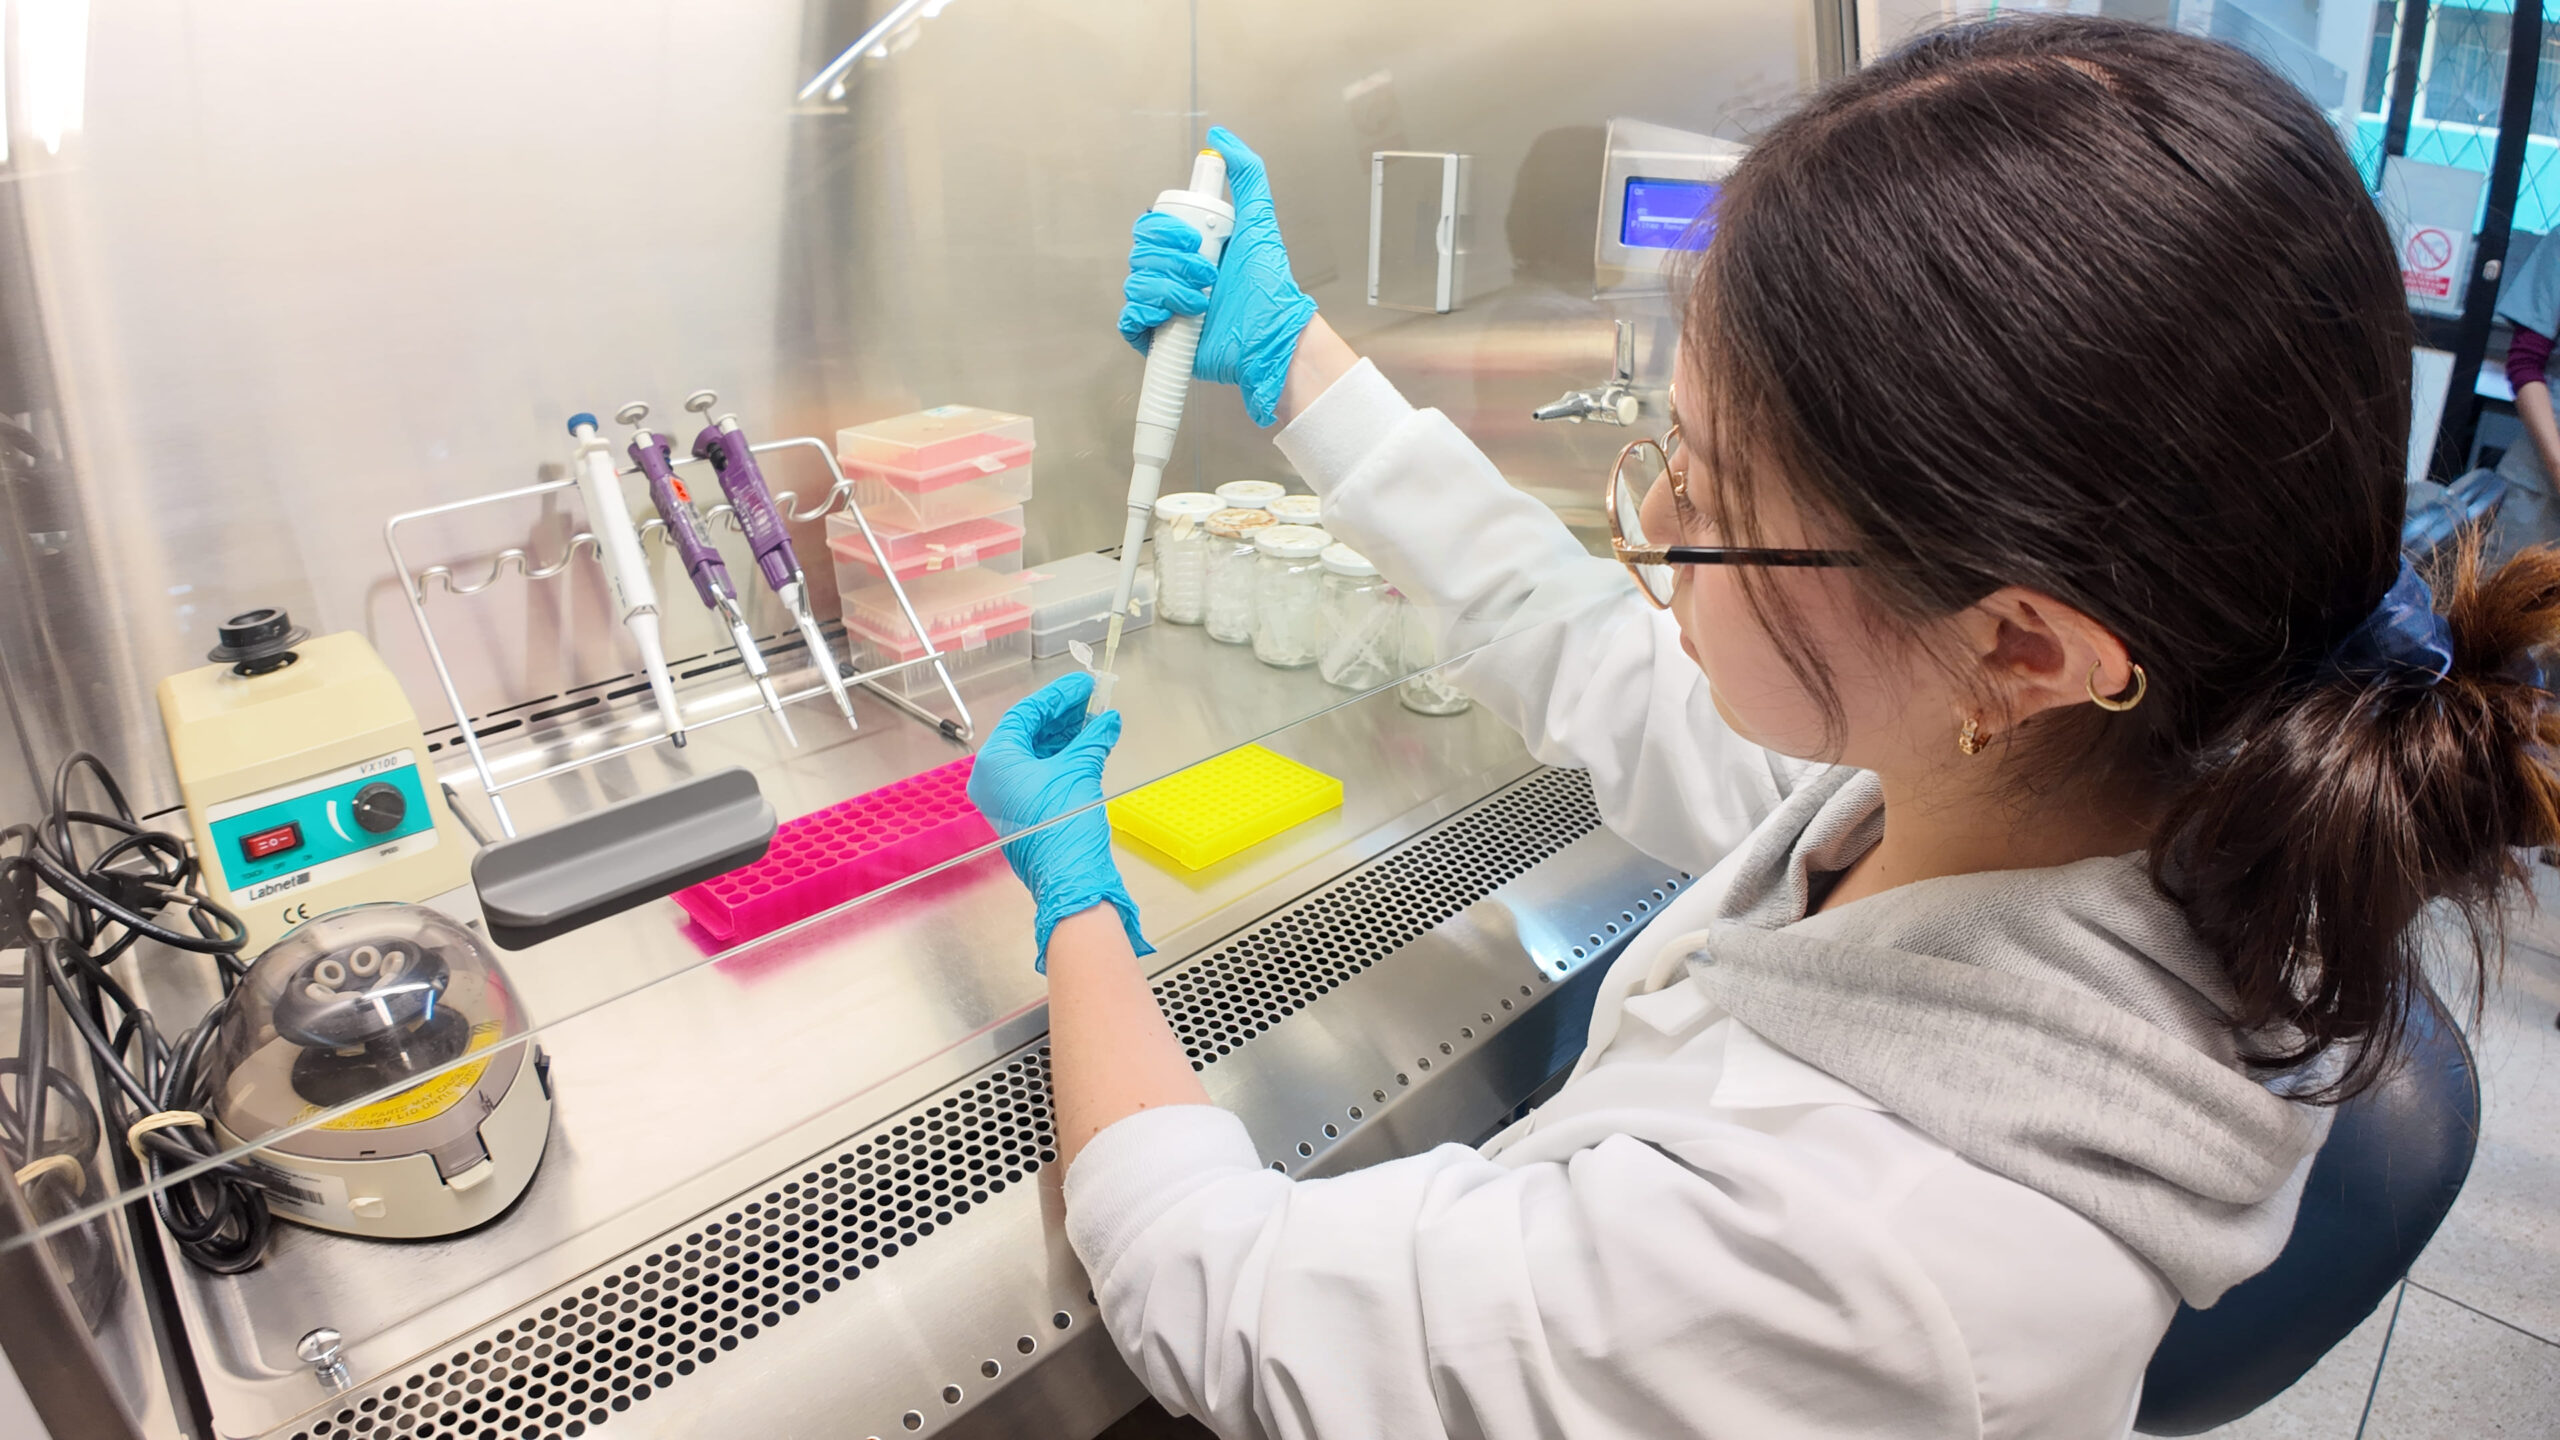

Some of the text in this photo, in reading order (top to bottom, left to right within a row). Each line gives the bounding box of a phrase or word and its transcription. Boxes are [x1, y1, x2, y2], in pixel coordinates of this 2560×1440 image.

[360, 756, 398, 774] VX100
[249, 876, 297, 901] Labnet
[412, 1092, 433, 1106] MAY
[397, 1108, 418, 1120] LID
